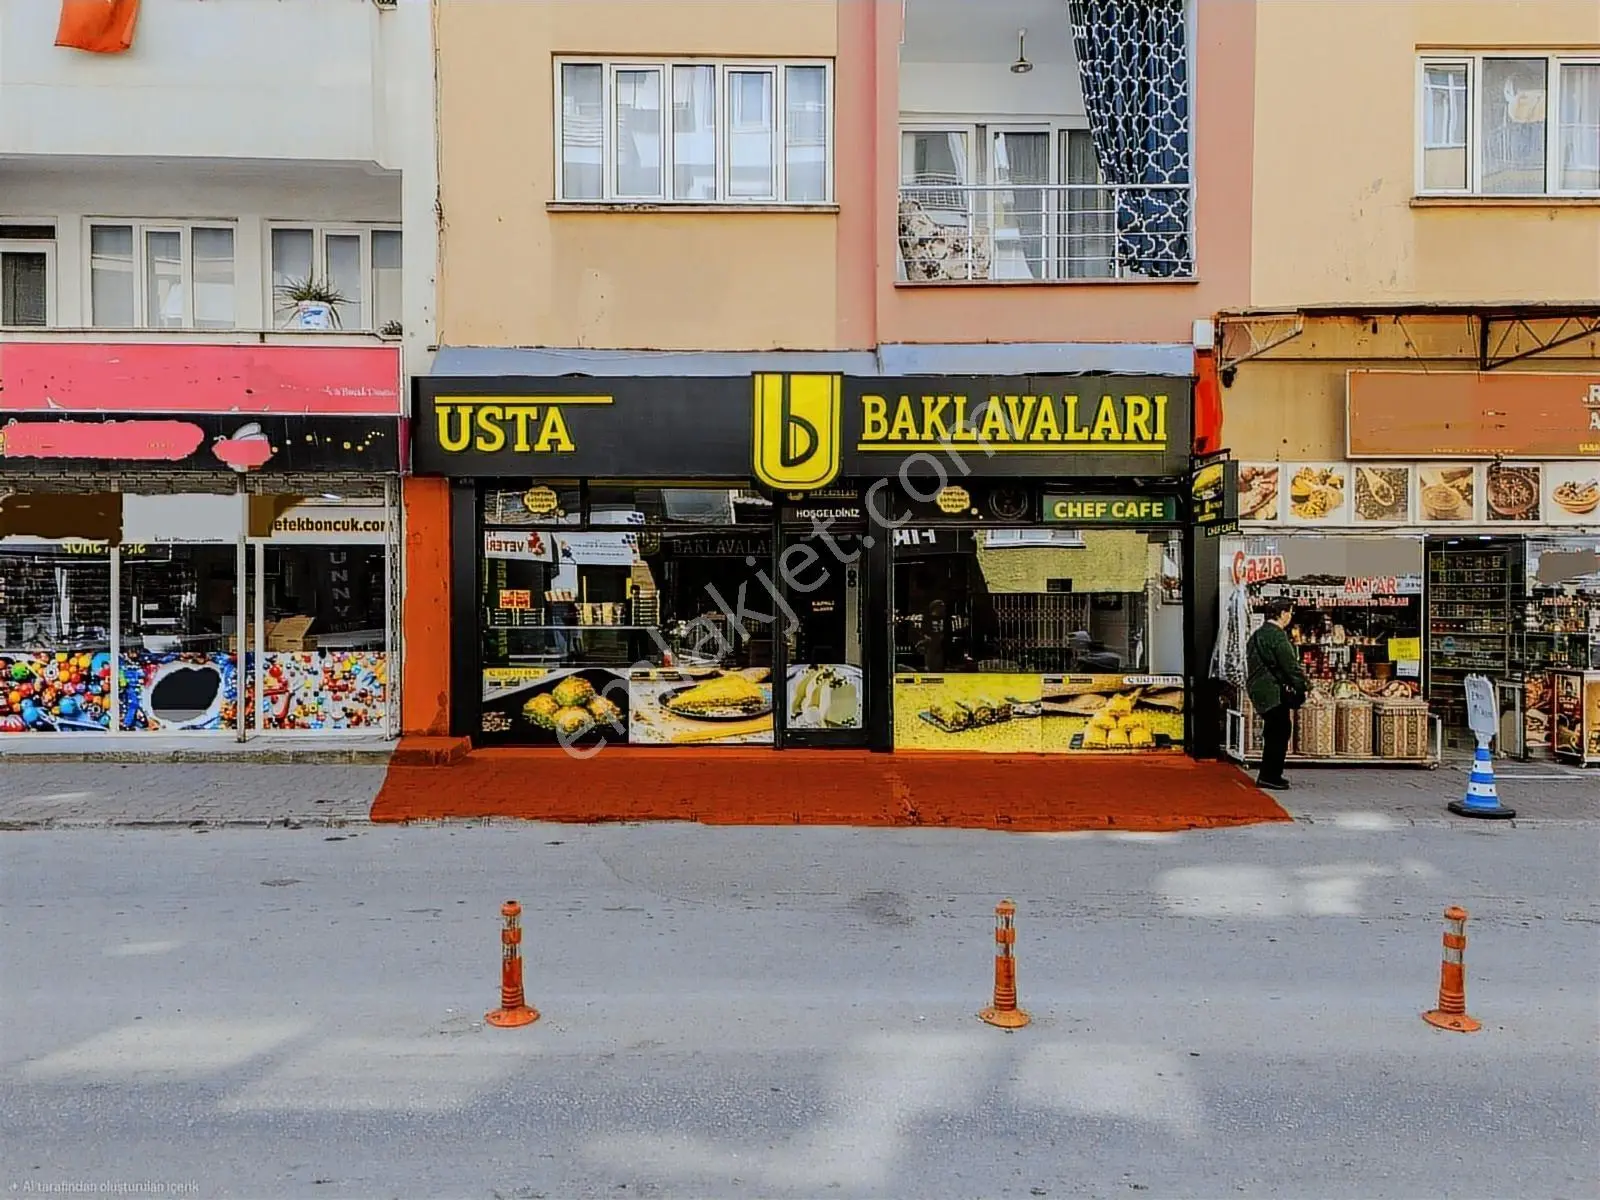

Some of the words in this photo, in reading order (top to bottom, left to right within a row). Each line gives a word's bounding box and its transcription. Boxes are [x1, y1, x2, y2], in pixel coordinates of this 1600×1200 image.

[435, 405, 575, 452] USTA
[862, 395, 1167, 441] BAKLAVALARI
[1054, 502, 1107, 518] CHEF
[1111, 502, 1164, 518] CAFE
[1344, 576, 1397, 594] AKTAR
